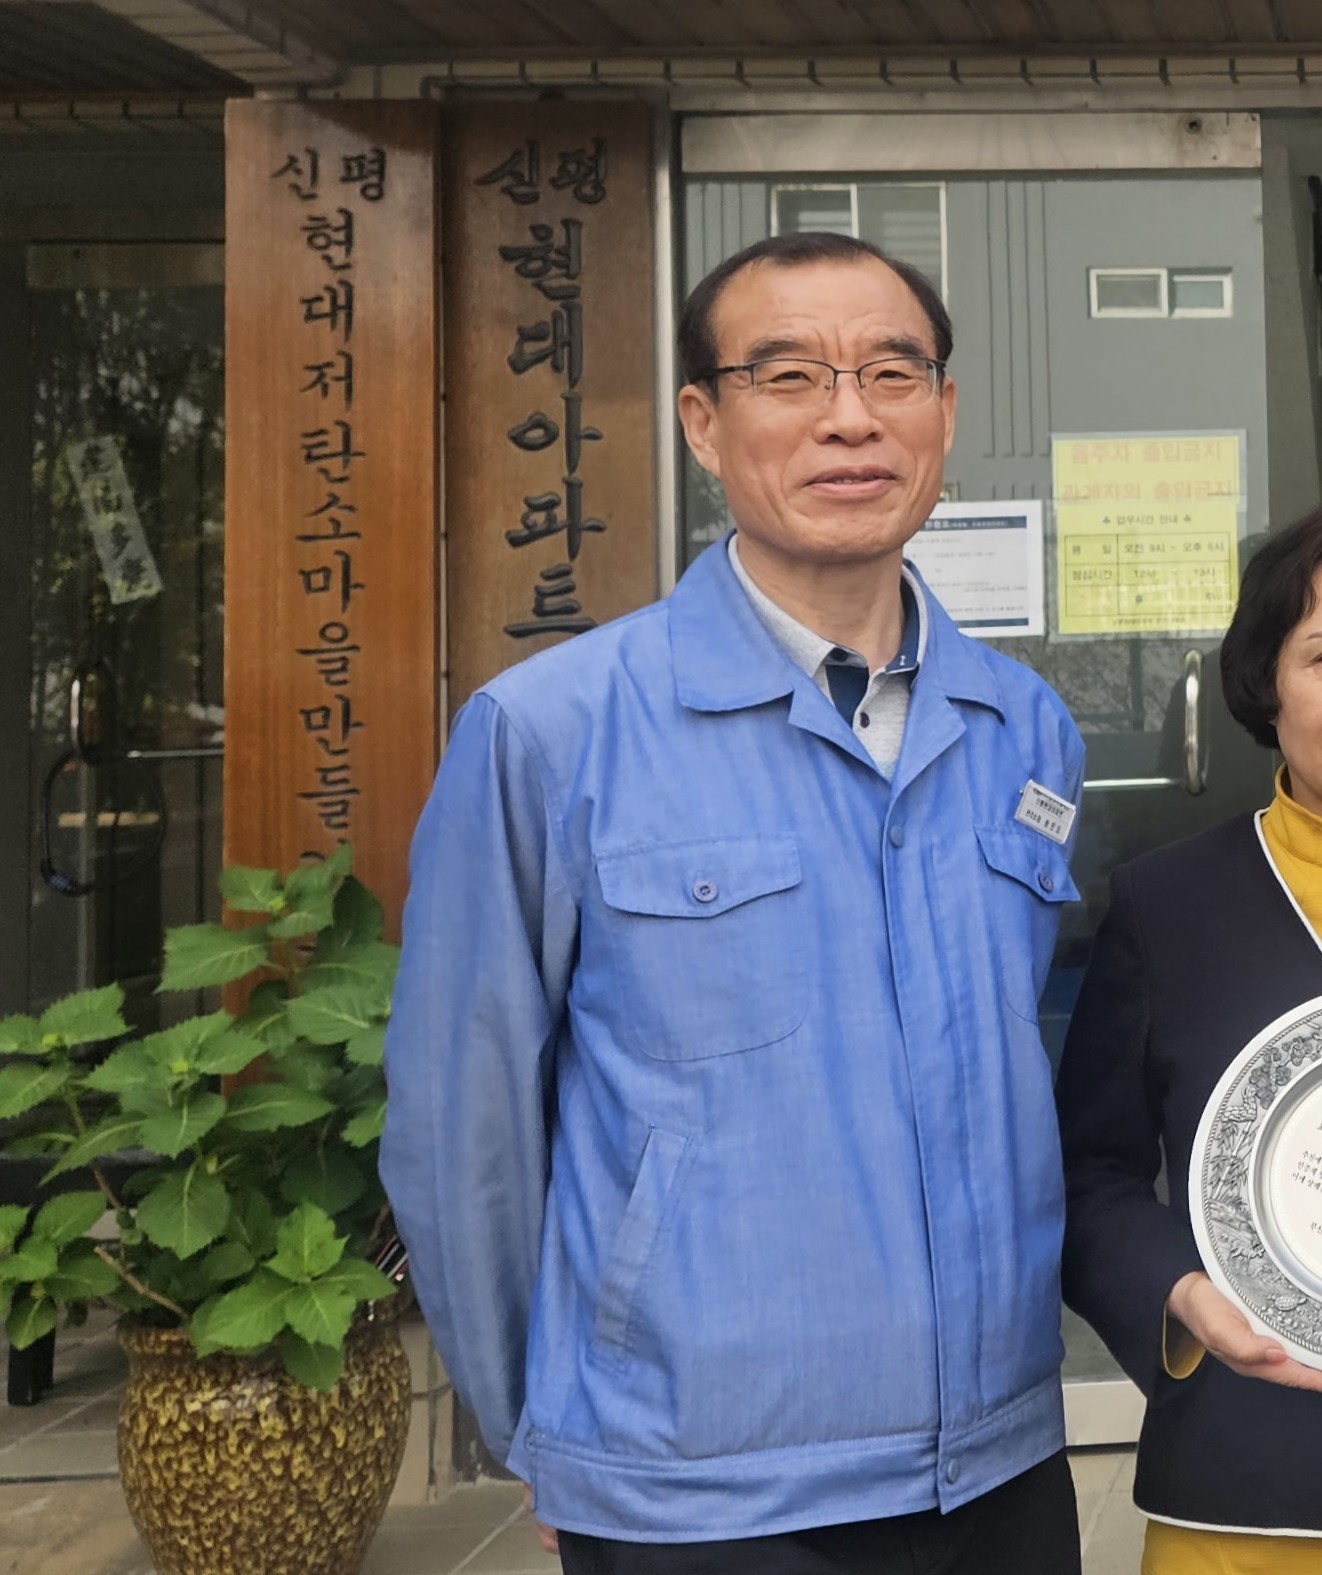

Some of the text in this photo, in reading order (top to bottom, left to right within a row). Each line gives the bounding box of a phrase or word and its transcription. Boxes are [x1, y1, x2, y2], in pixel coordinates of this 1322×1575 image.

[270, 147, 388, 202] 신평
[475, 138, 609, 203] 신평
[499, 218, 606, 639] 현대아파트
